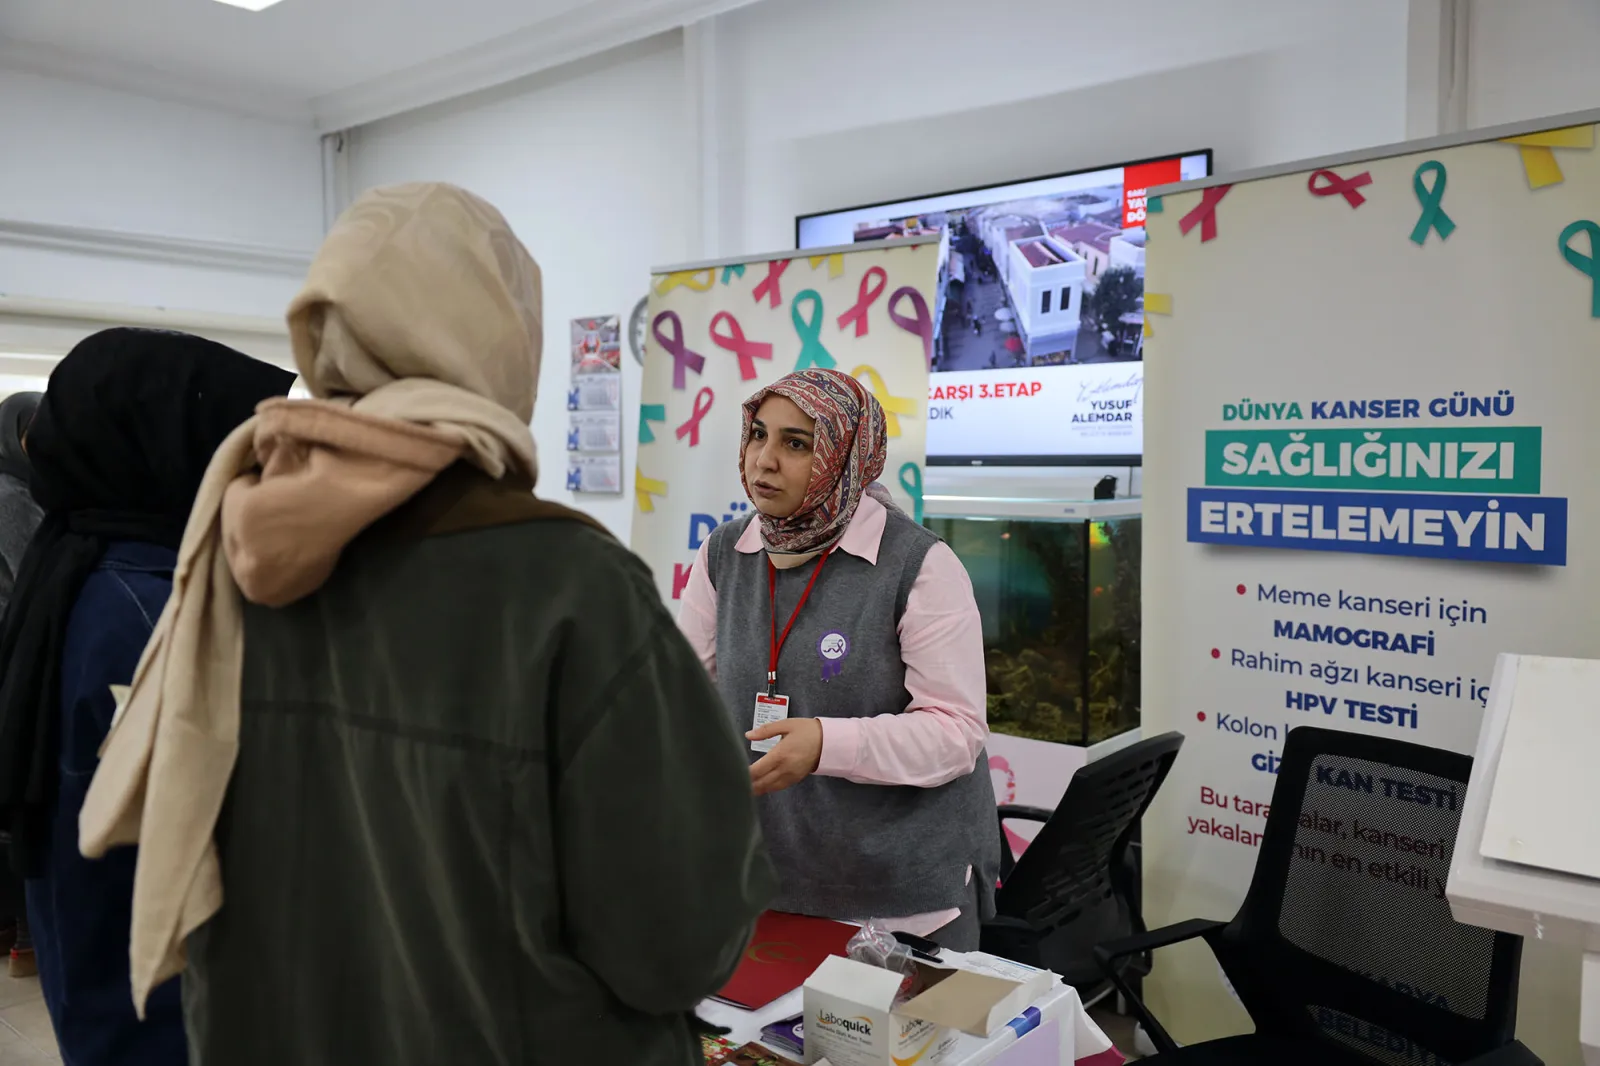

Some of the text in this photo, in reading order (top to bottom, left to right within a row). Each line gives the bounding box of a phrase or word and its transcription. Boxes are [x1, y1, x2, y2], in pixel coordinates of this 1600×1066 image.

[928, 381, 1042, 402] ARŞI 3.ETAP
[1091, 400, 1132, 410] YUSUF
[1222, 390, 1515, 421] DÜNYA KANSER GÜNÜ
[1072, 412, 1132, 422] ALEMDAR
[1221, 431, 1515, 480] SAĞLIĞINIZI
[1200, 499, 1546, 551] ERTELEMEYİN
[1257, 583, 1488, 627] Meme kanseri için
[1273, 619, 1435, 656] MAMOGRAFİ
[1231, 648, 1303, 676] Rahim
[1309, 660, 1359, 686] ağzı
[1366, 666, 1461, 699] kanseri
[1216, 712, 1277, 740] Kolon
[1286, 690, 1418, 729] HPV TESTİ
[1316, 764, 1373, 794] KAN
[1379, 777, 1456, 810] TESTİ
[1200, 786, 1228, 809] Bu
[1354, 820, 1445, 860] kanseri
[1368, 862, 1429, 890] etkili
[819, 1008, 872, 1036] Laboquick
